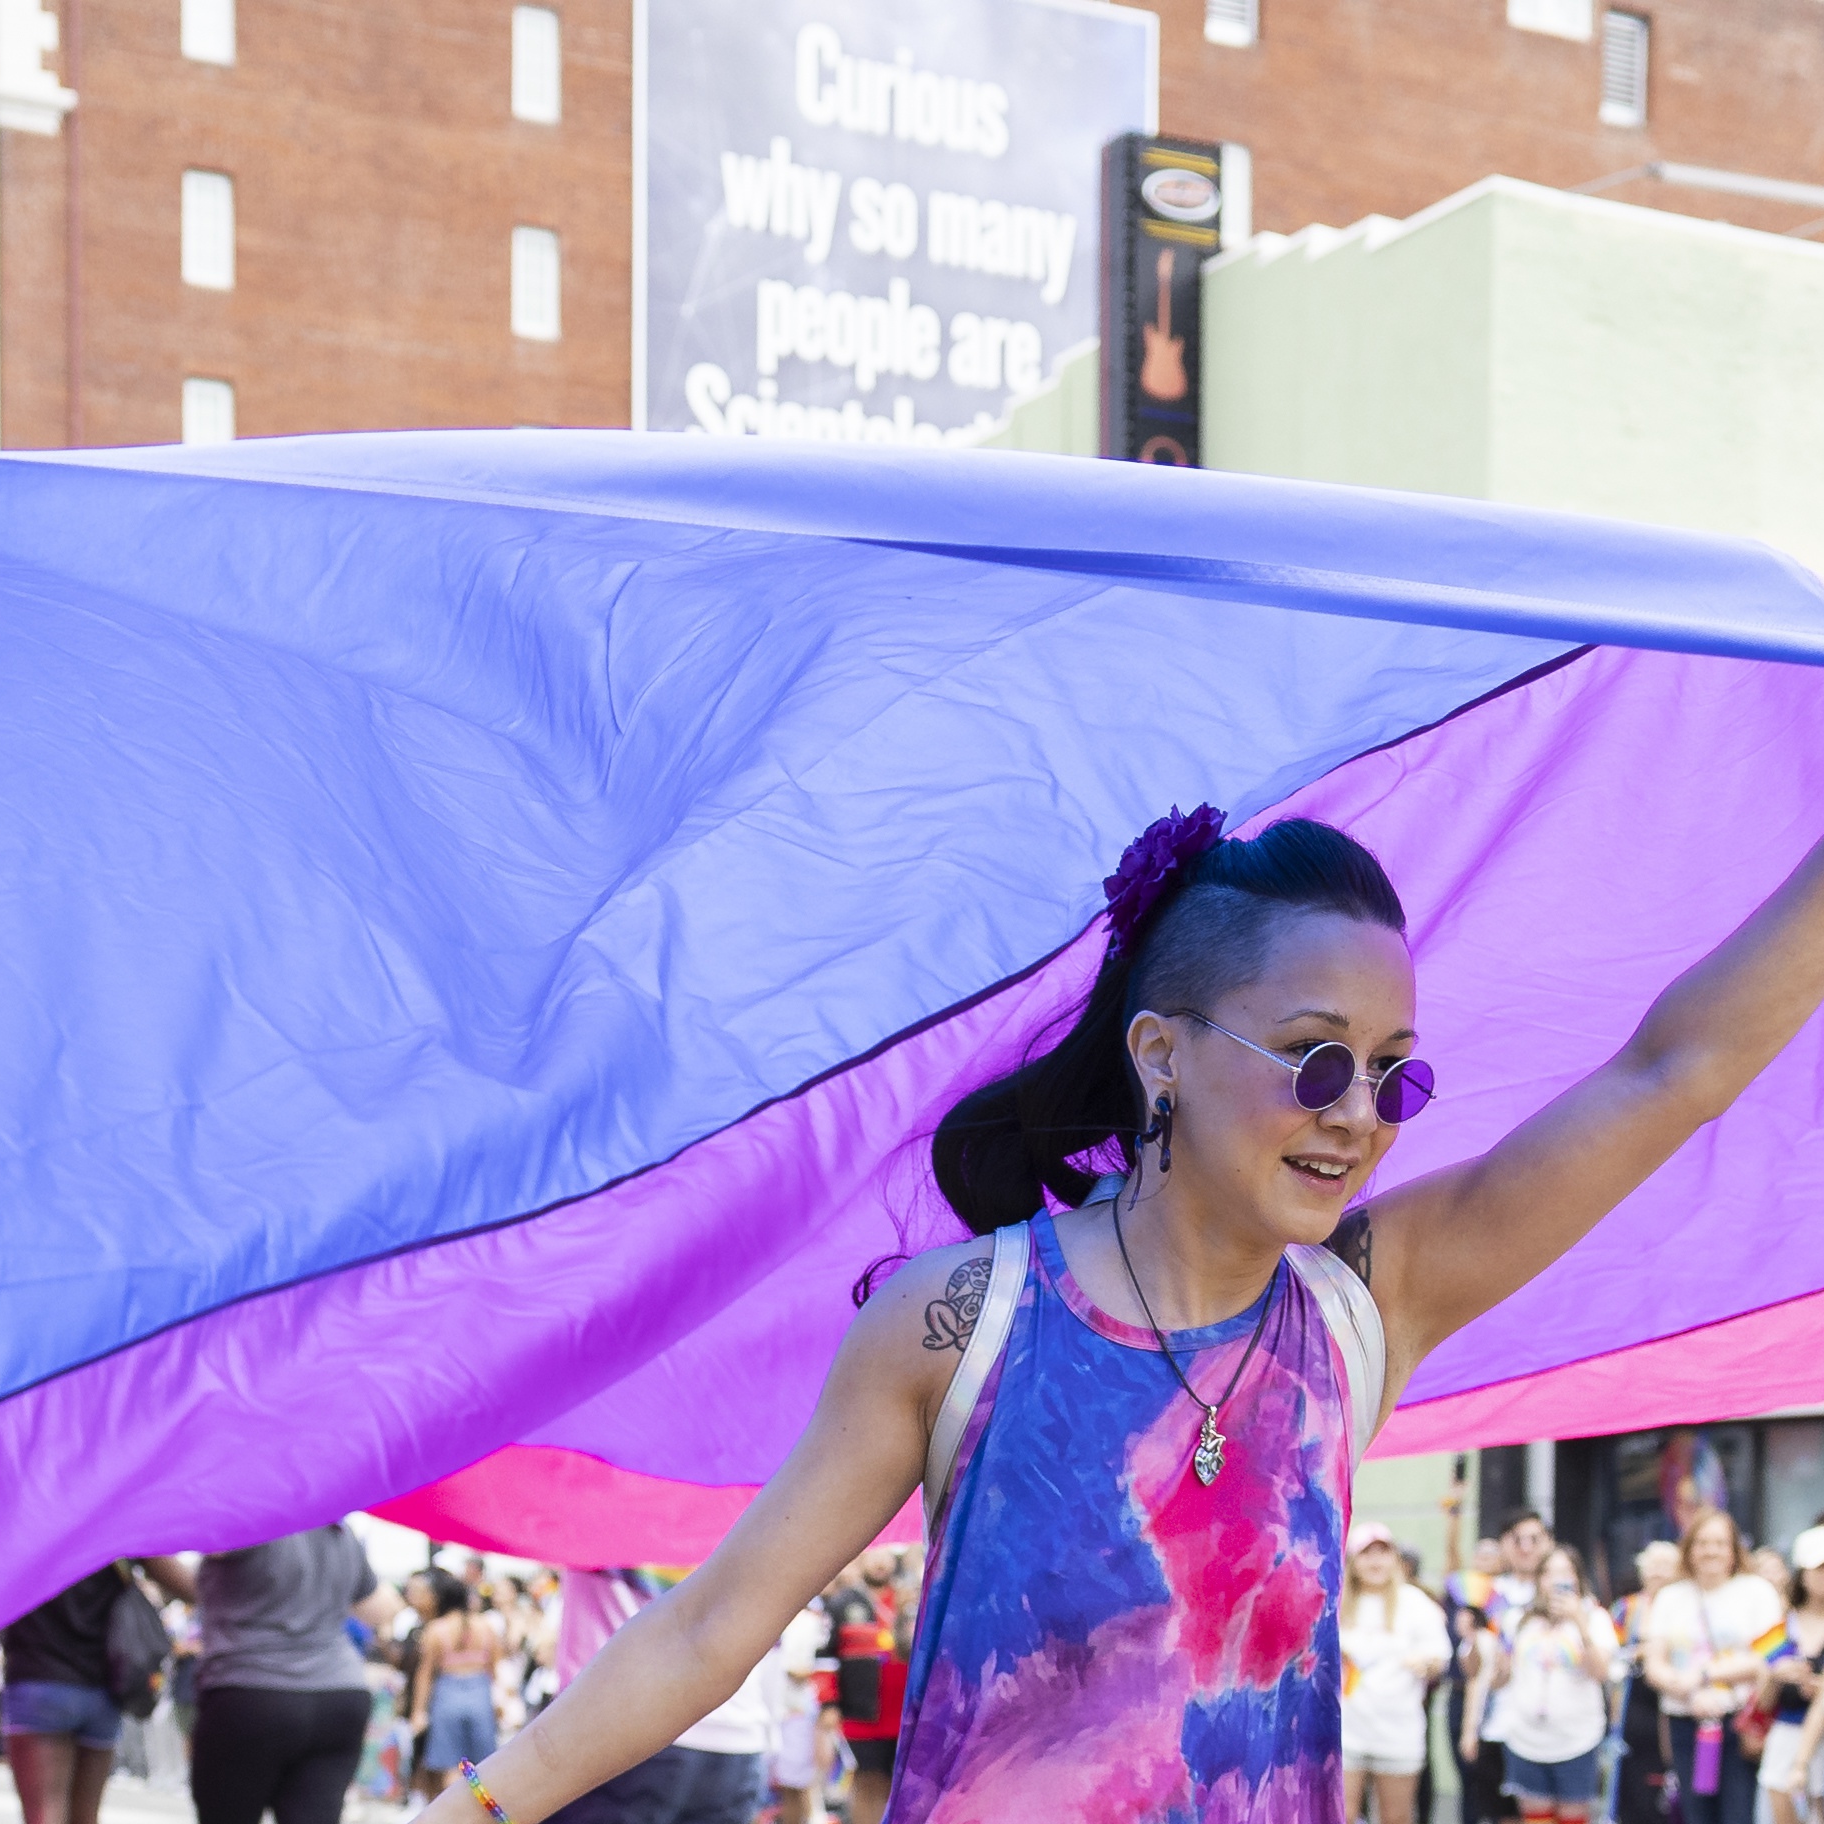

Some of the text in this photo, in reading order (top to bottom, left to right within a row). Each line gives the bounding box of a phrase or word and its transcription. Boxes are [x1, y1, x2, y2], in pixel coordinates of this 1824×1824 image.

[794, 22, 1010, 158] Curious
[720, 135, 1077, 306] why so many
[756, 277, 1043, 396] people are
